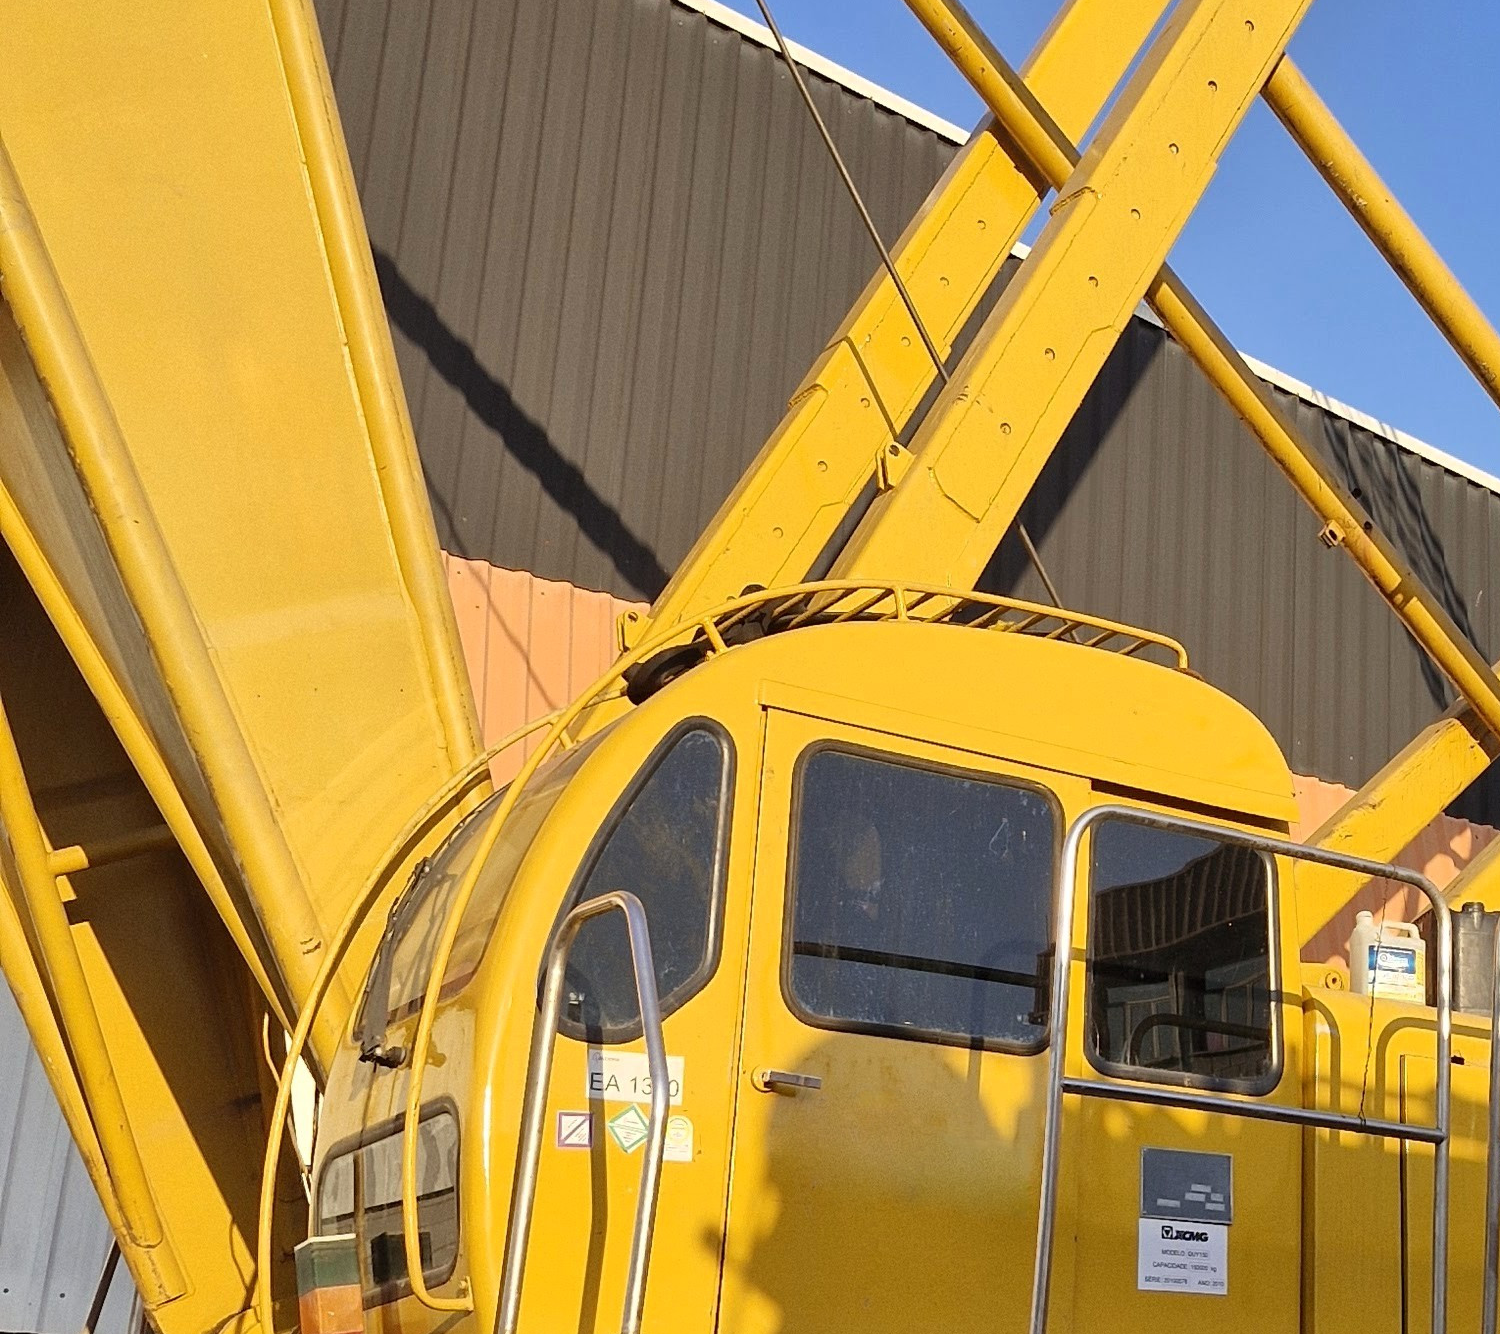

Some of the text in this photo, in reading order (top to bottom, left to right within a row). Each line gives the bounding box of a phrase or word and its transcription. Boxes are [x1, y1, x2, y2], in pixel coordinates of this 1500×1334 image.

[590, 1072, 679, 1097] EA 130
[1174, 1230, 1209, 1242] XCMG
